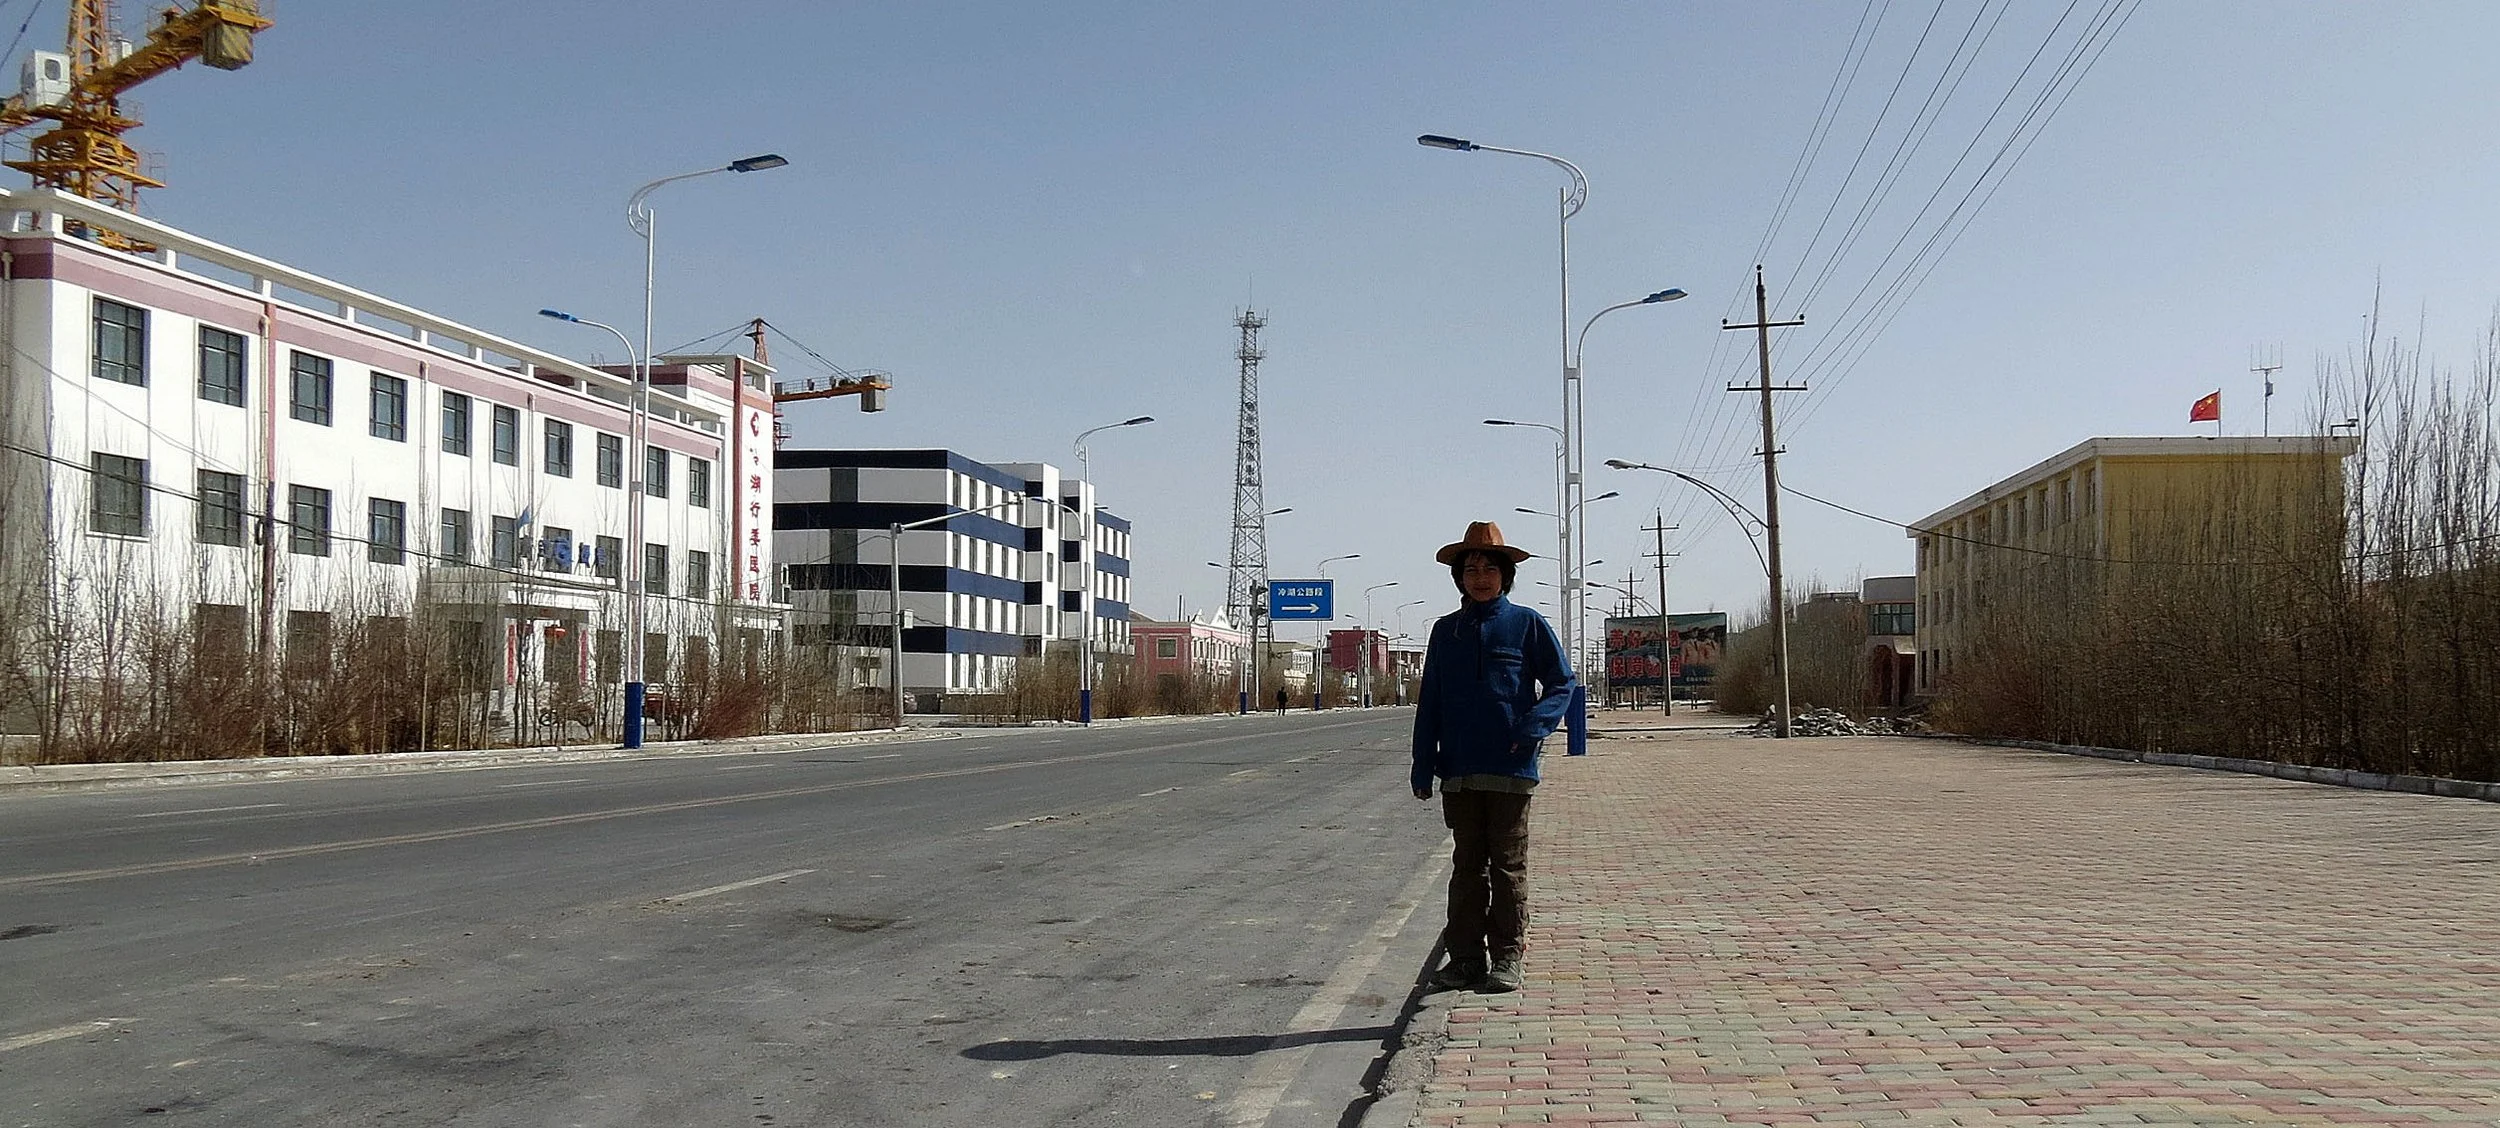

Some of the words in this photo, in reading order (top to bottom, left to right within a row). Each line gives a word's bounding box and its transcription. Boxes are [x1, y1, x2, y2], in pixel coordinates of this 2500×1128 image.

[1278, 587, 1323, 597] 冷湖公路段
